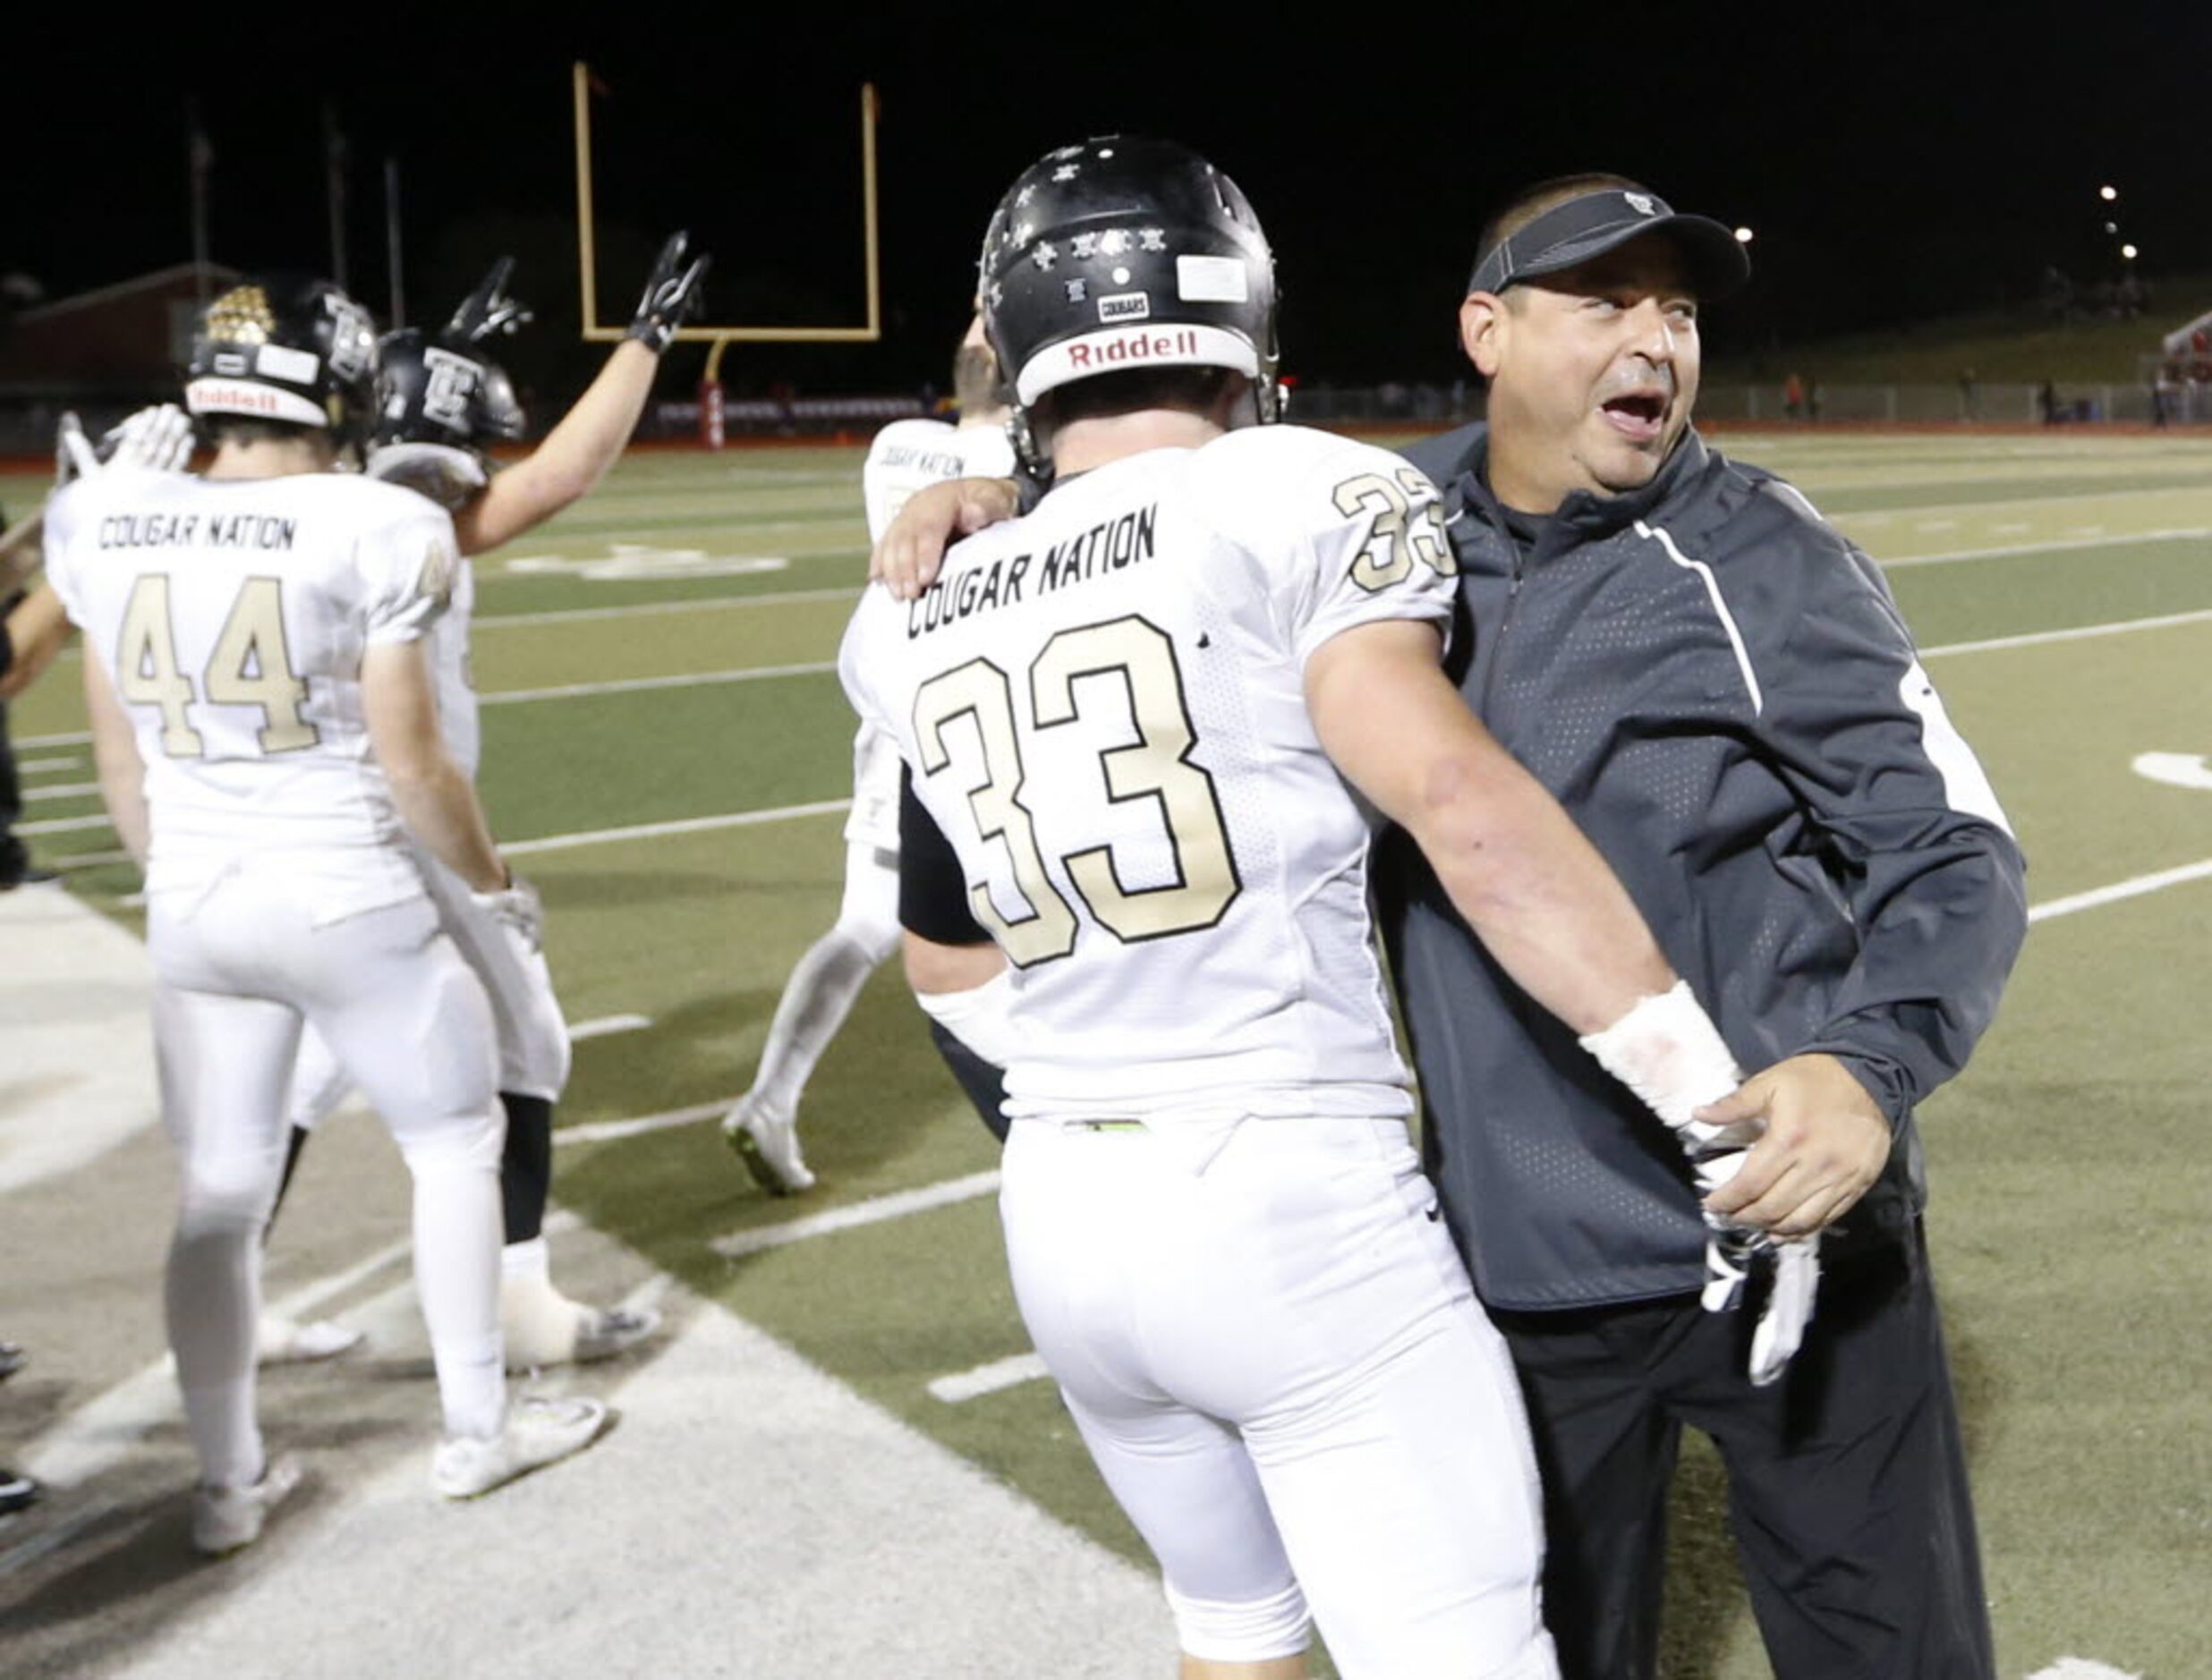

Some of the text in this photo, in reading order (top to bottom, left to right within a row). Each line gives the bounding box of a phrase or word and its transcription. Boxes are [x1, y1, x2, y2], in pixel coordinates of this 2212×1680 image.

[1068, 331, 1198, 368] Riddell
[1102, 297, 1146, 317] COUGARS
[99, 514, 297, 550] COUGAR NATION
[907, 501, 1158, 641] COUGAR NATION
[1331, 467, 1458, 593] 33
[118, 573, 320, 759] 44
[912, 613, 1243, 970] 33
